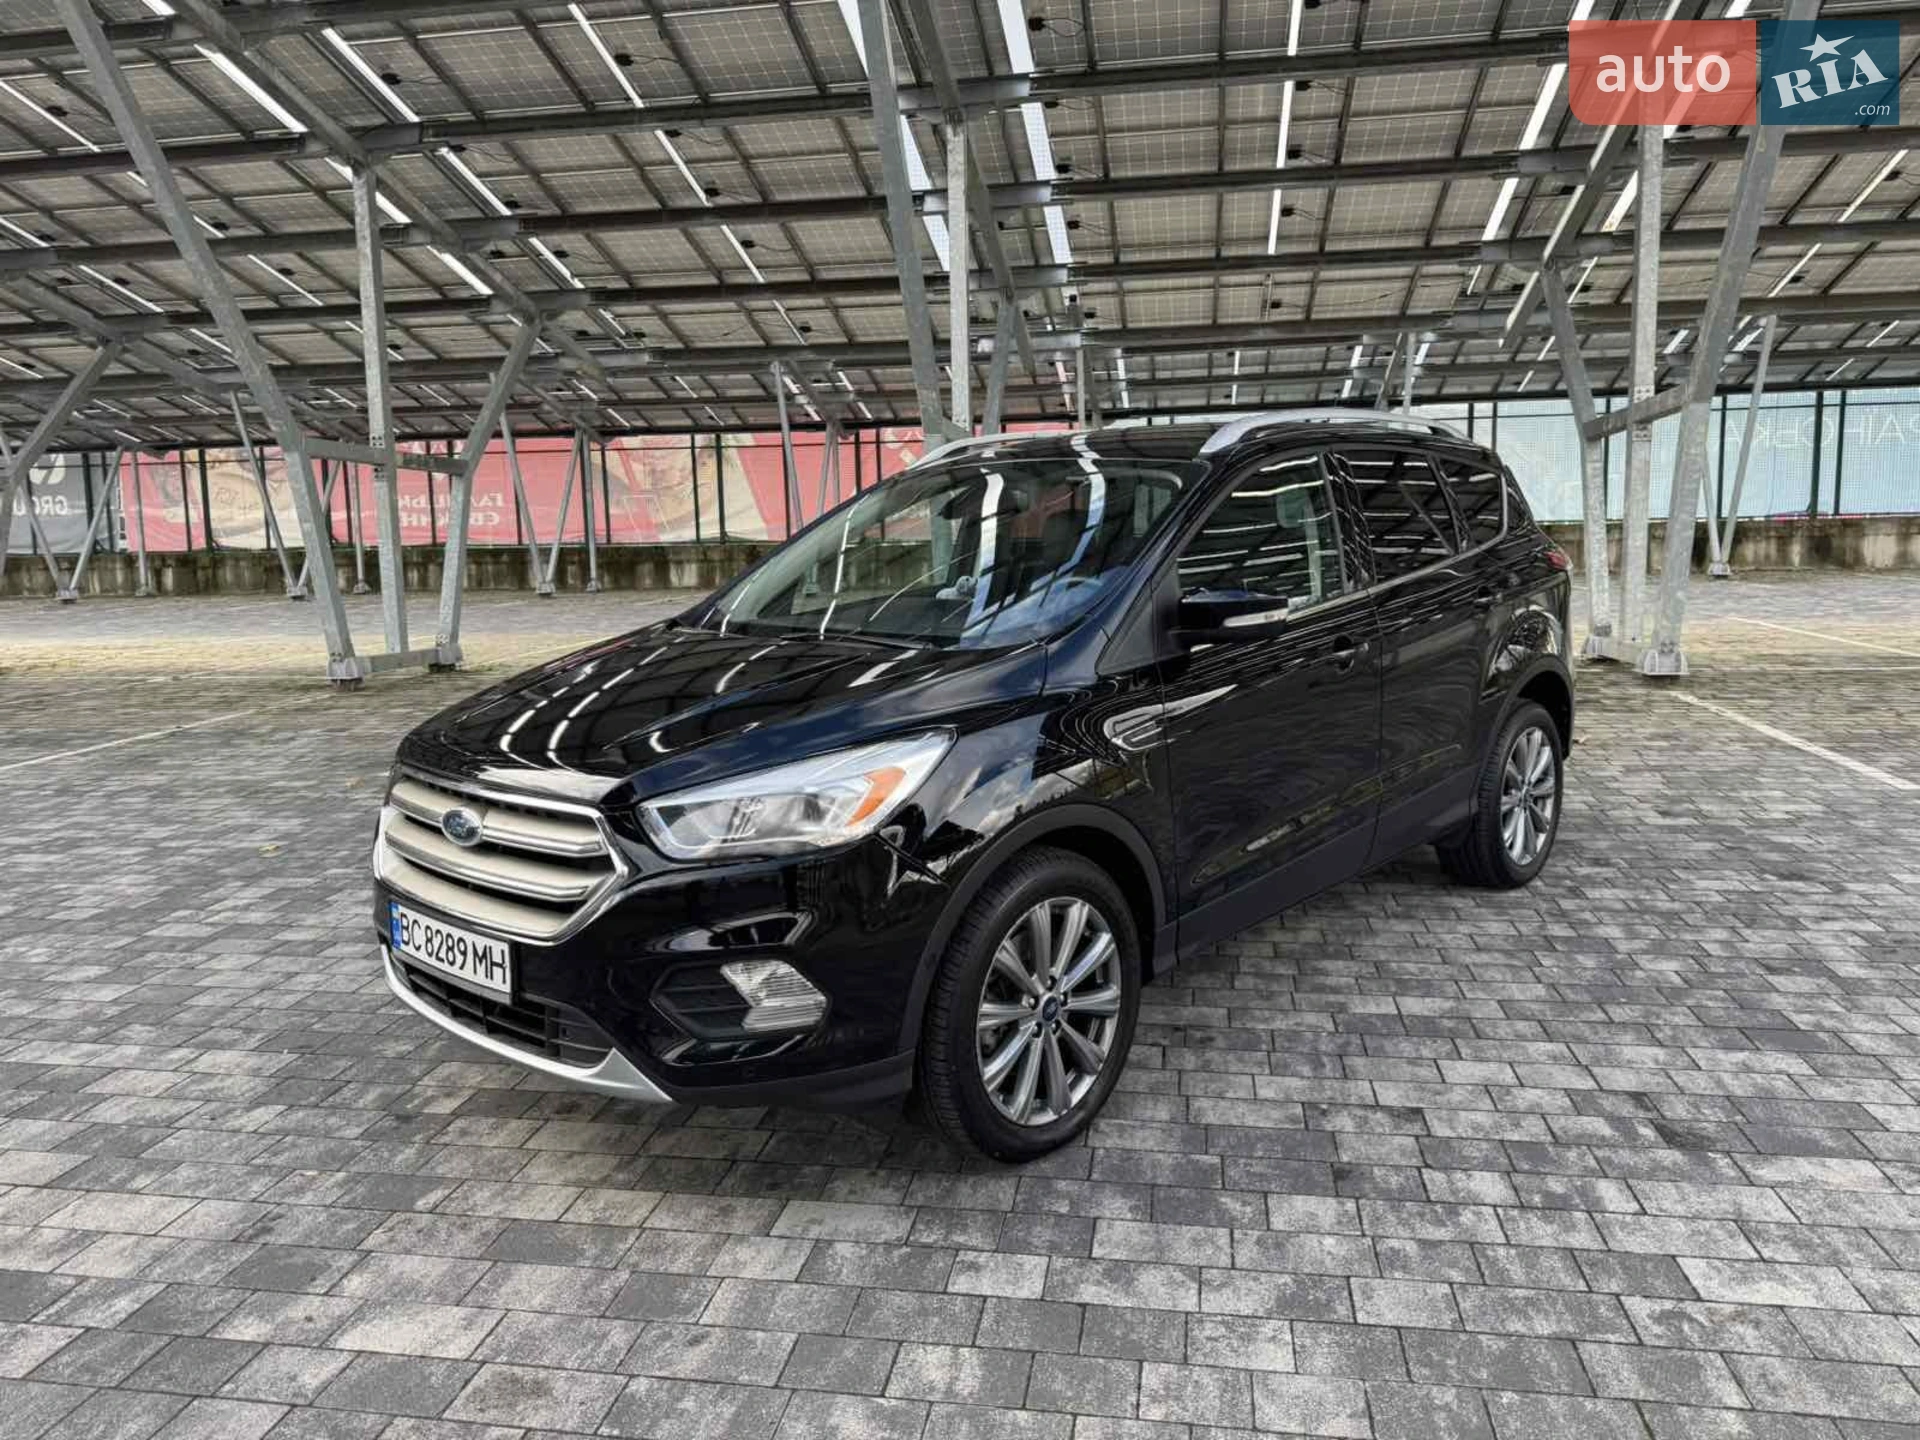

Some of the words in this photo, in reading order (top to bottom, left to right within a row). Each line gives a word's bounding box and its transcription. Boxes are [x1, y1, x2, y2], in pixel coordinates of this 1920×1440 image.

[401, 912, 422, 951] BC
[425, 925, 469, 972] 8289
[472, 940, 508, 985] MH
